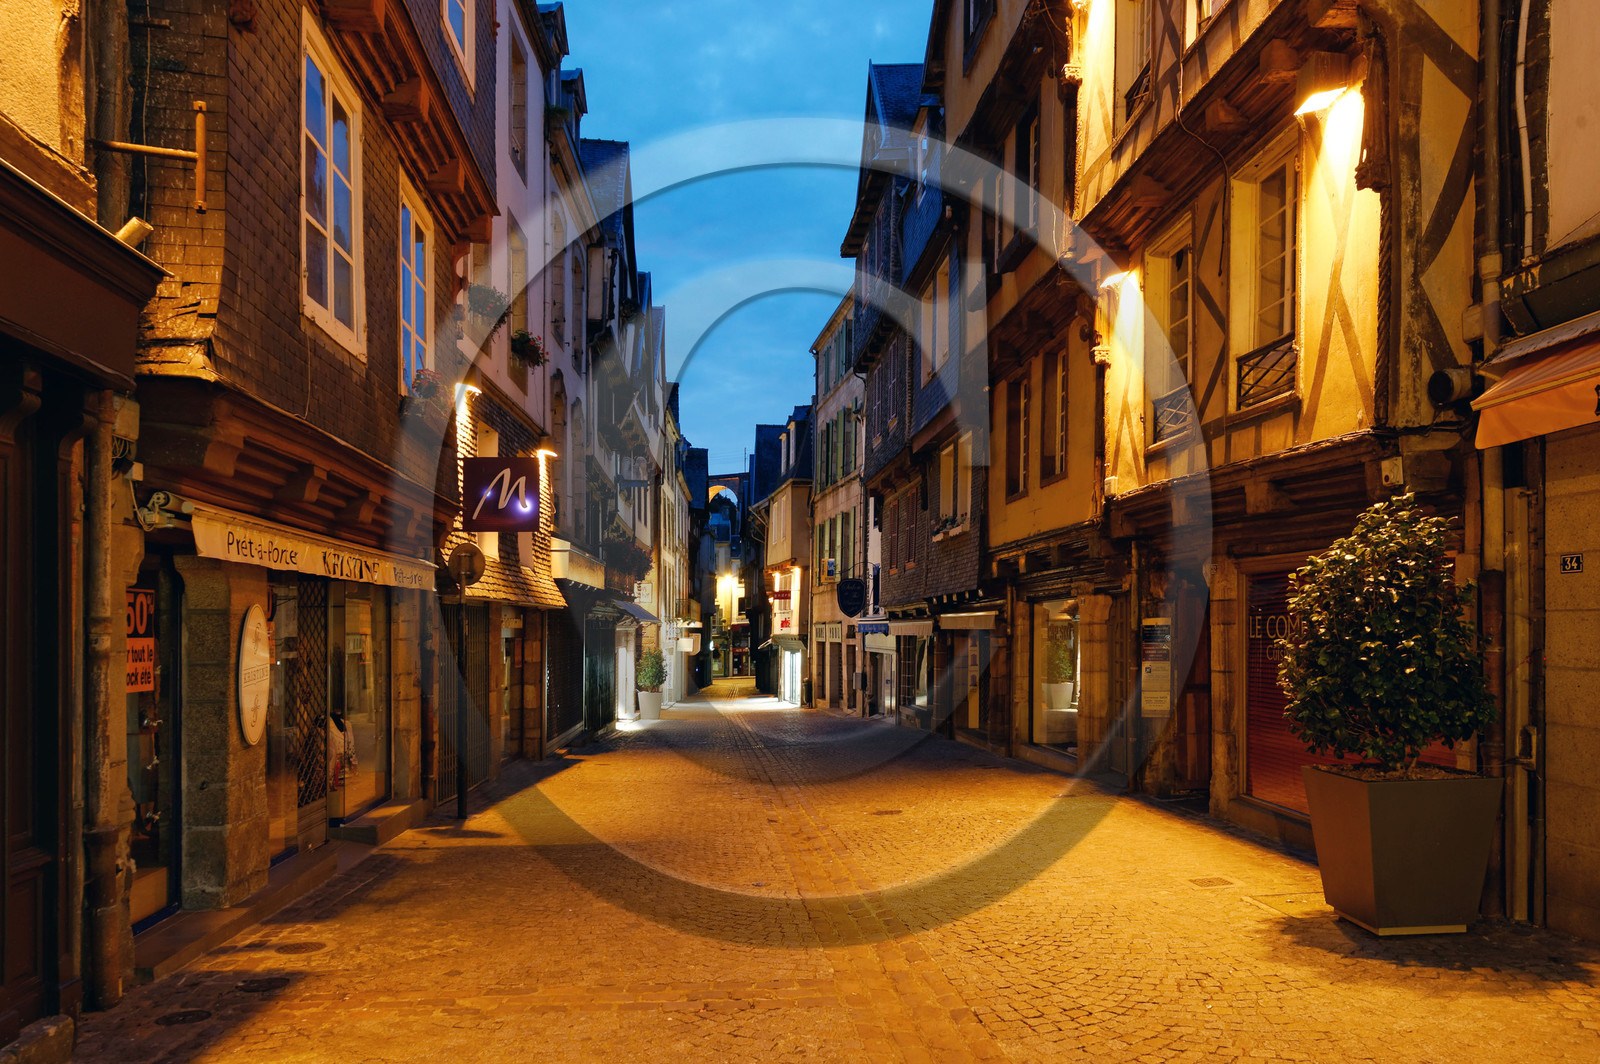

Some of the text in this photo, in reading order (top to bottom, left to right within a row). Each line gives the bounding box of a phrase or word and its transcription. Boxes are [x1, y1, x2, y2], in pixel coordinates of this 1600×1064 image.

[1564, 557, 1578, 570] 34
[1249, 615, 1262, 639] LE
[132, 645, 145, 663] tout
[147, 644, 153, 662] le
[140, 666, 151, 685] été
